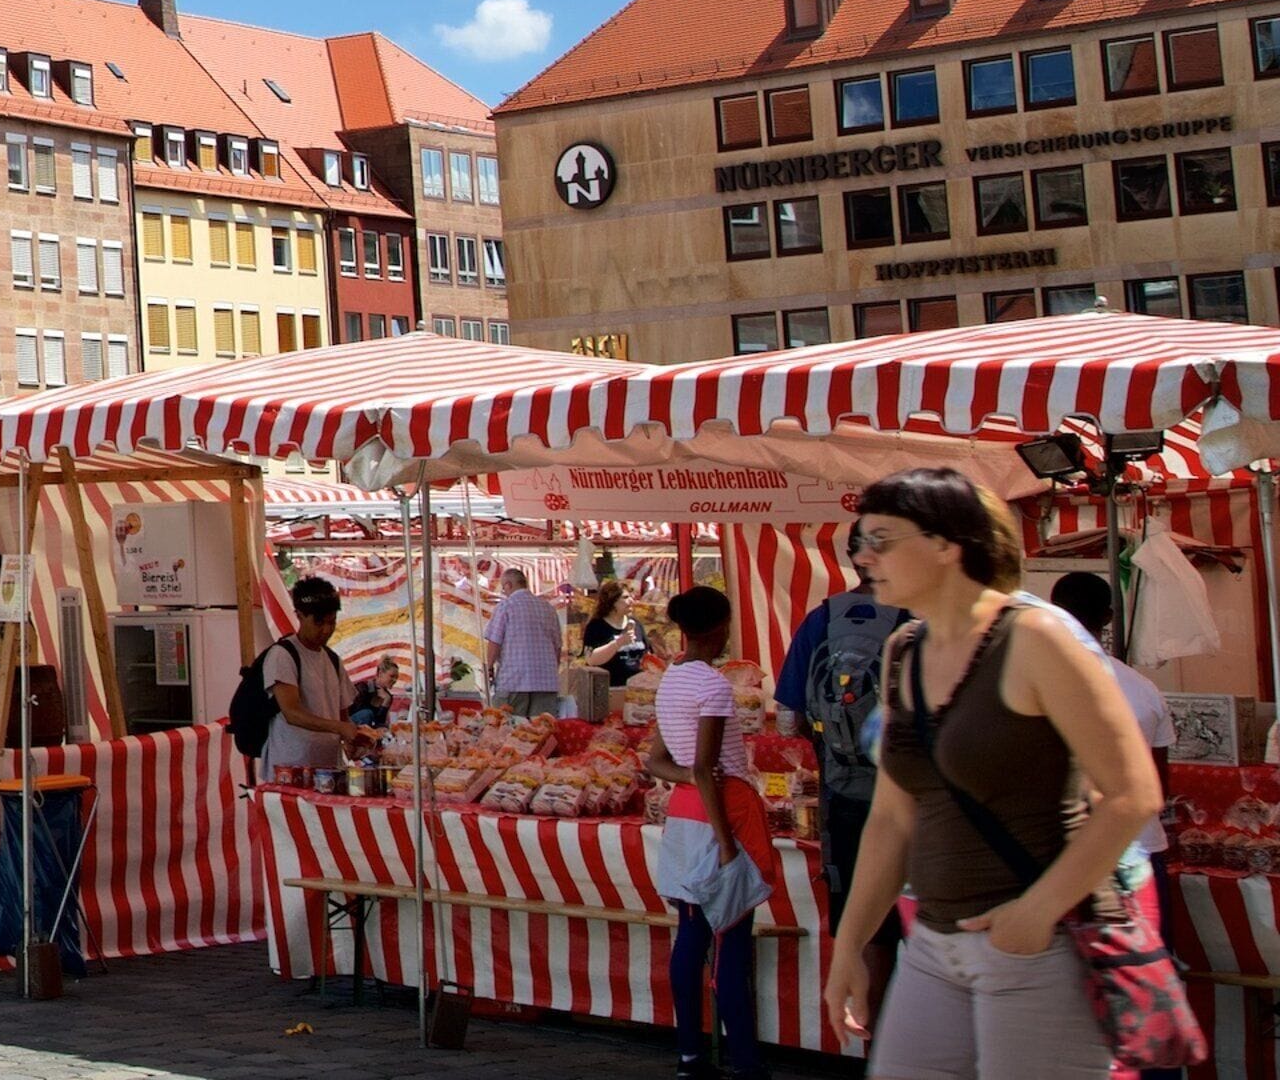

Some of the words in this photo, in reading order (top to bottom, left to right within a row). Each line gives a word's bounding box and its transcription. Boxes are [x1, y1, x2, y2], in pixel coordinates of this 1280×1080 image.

[714, 140, 944, 193] NÜRNBERGER
[965, 116, 1234, 163] VERSICHERUNGSGRUPPE
[567, 181, 601, 205] N
[569, 468, 654, 492] Nürnberger
[658, 469, 788, 490] Lebkuchenhaus
[690, 501, 773, 513] GOLLMANN
[142, 571, 174, 582] Biereis
[160, 582, 182, 593] Stiel
